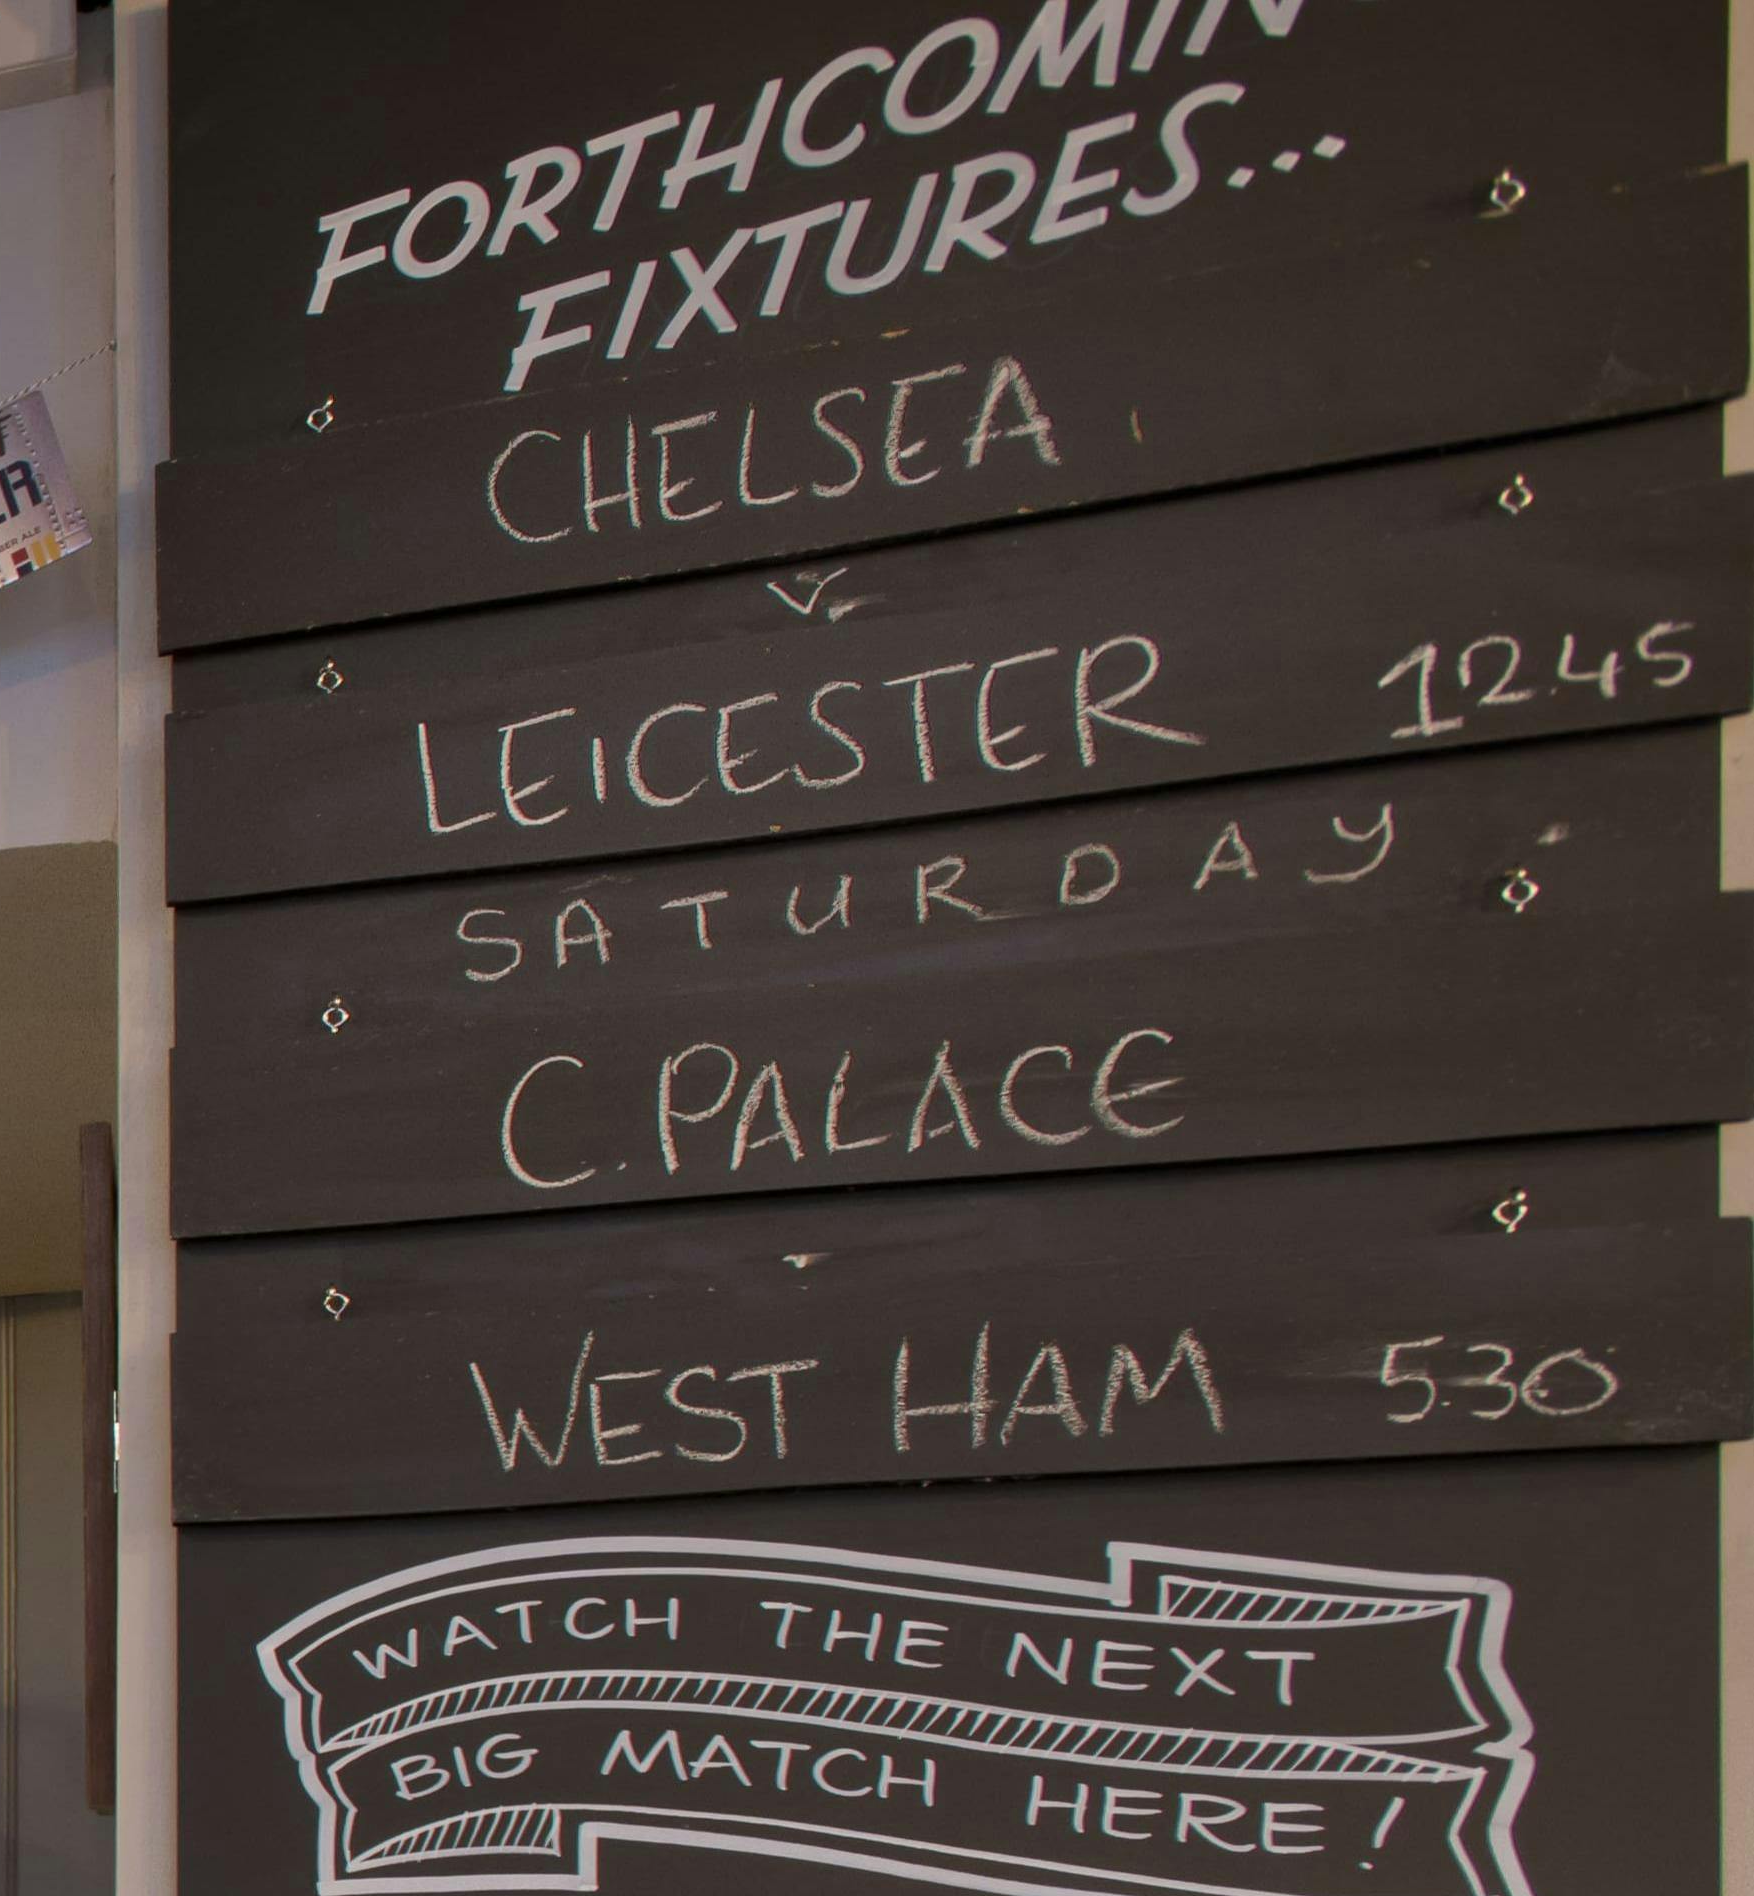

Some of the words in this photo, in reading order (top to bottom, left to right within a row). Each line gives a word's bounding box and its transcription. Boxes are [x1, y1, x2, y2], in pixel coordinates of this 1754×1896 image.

[307, 0, 1304, 314] FORTHCOMIN
[504, 83, 1344, 391] FIXTURES...
[21, 525, 42, 542] ALE
[487, 356, 1060, 543] CHELSEA
[417, 634, 1205, 834] LEICESTER
[457, 802, 1394, 982] SATURDAY
[468, 1331, 820, 1474] WEST
[893, 1320, 1229, 1453] HAM
[349, 1594, 686, 1681] WATCH
[758, 1600, 954, 1674] THE
[1002, 1628, 1317, 1707] NEXT
[387, 1730, 541, 1804] BIG
[597, 1727, 943, 1811] MATCH
